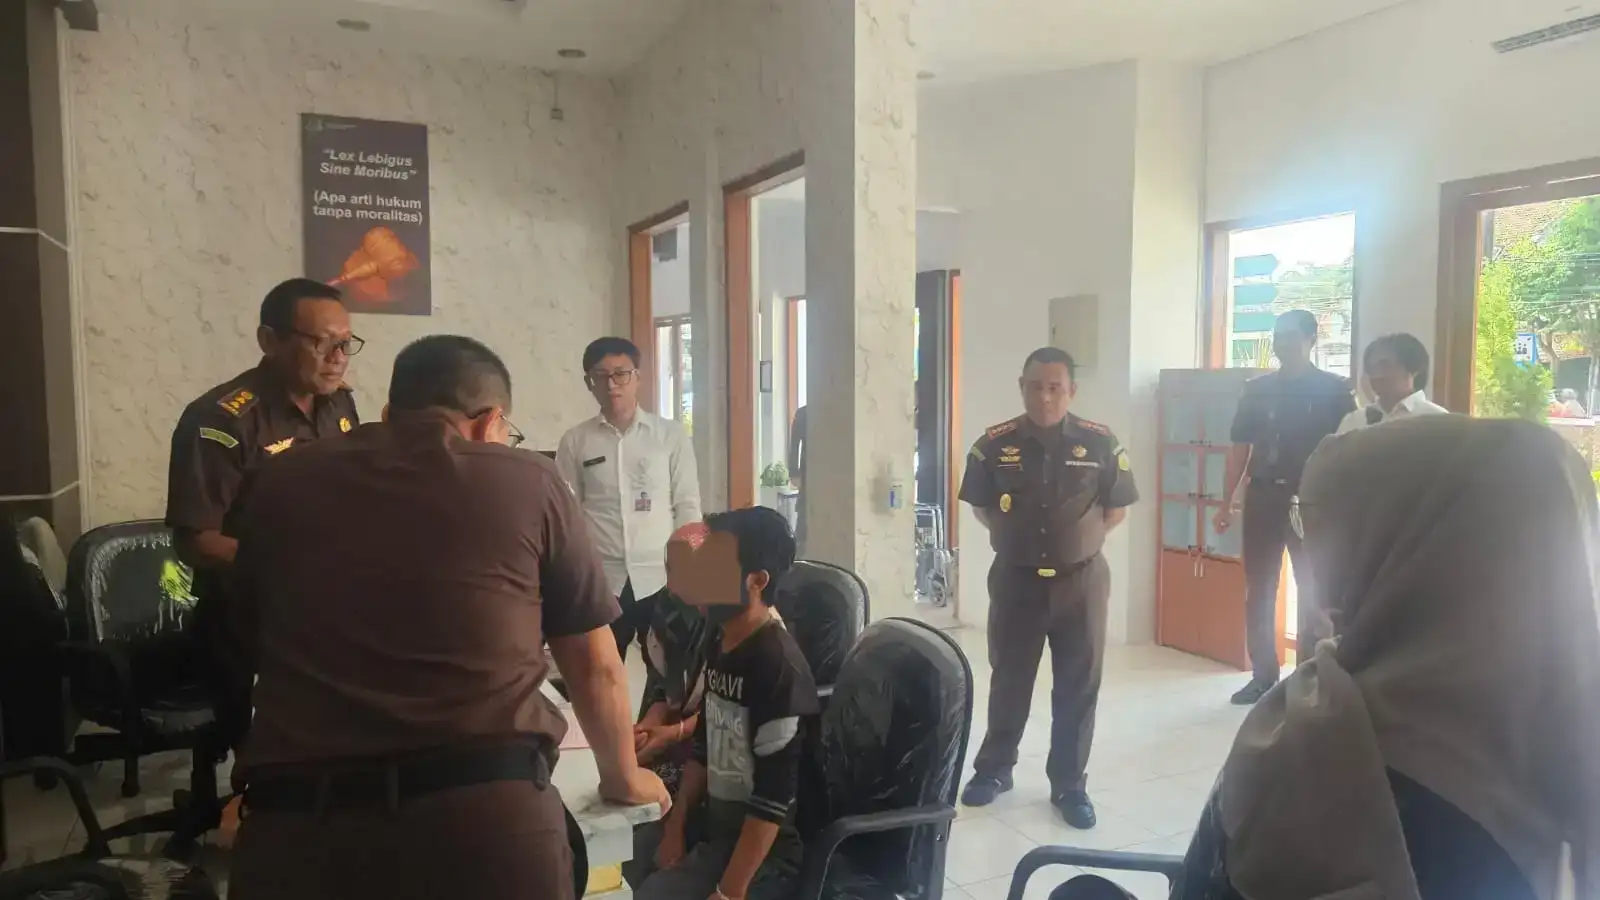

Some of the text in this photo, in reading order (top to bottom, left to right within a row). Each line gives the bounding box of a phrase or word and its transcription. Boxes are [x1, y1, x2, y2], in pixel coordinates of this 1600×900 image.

[359, 151, 413, 167] Lebigus
[320, 162, 351, 175] Sine
[314, 190, 421, 209] (Apa arti hukum
[313, 205, 423, 225] tanpa moralitas)
